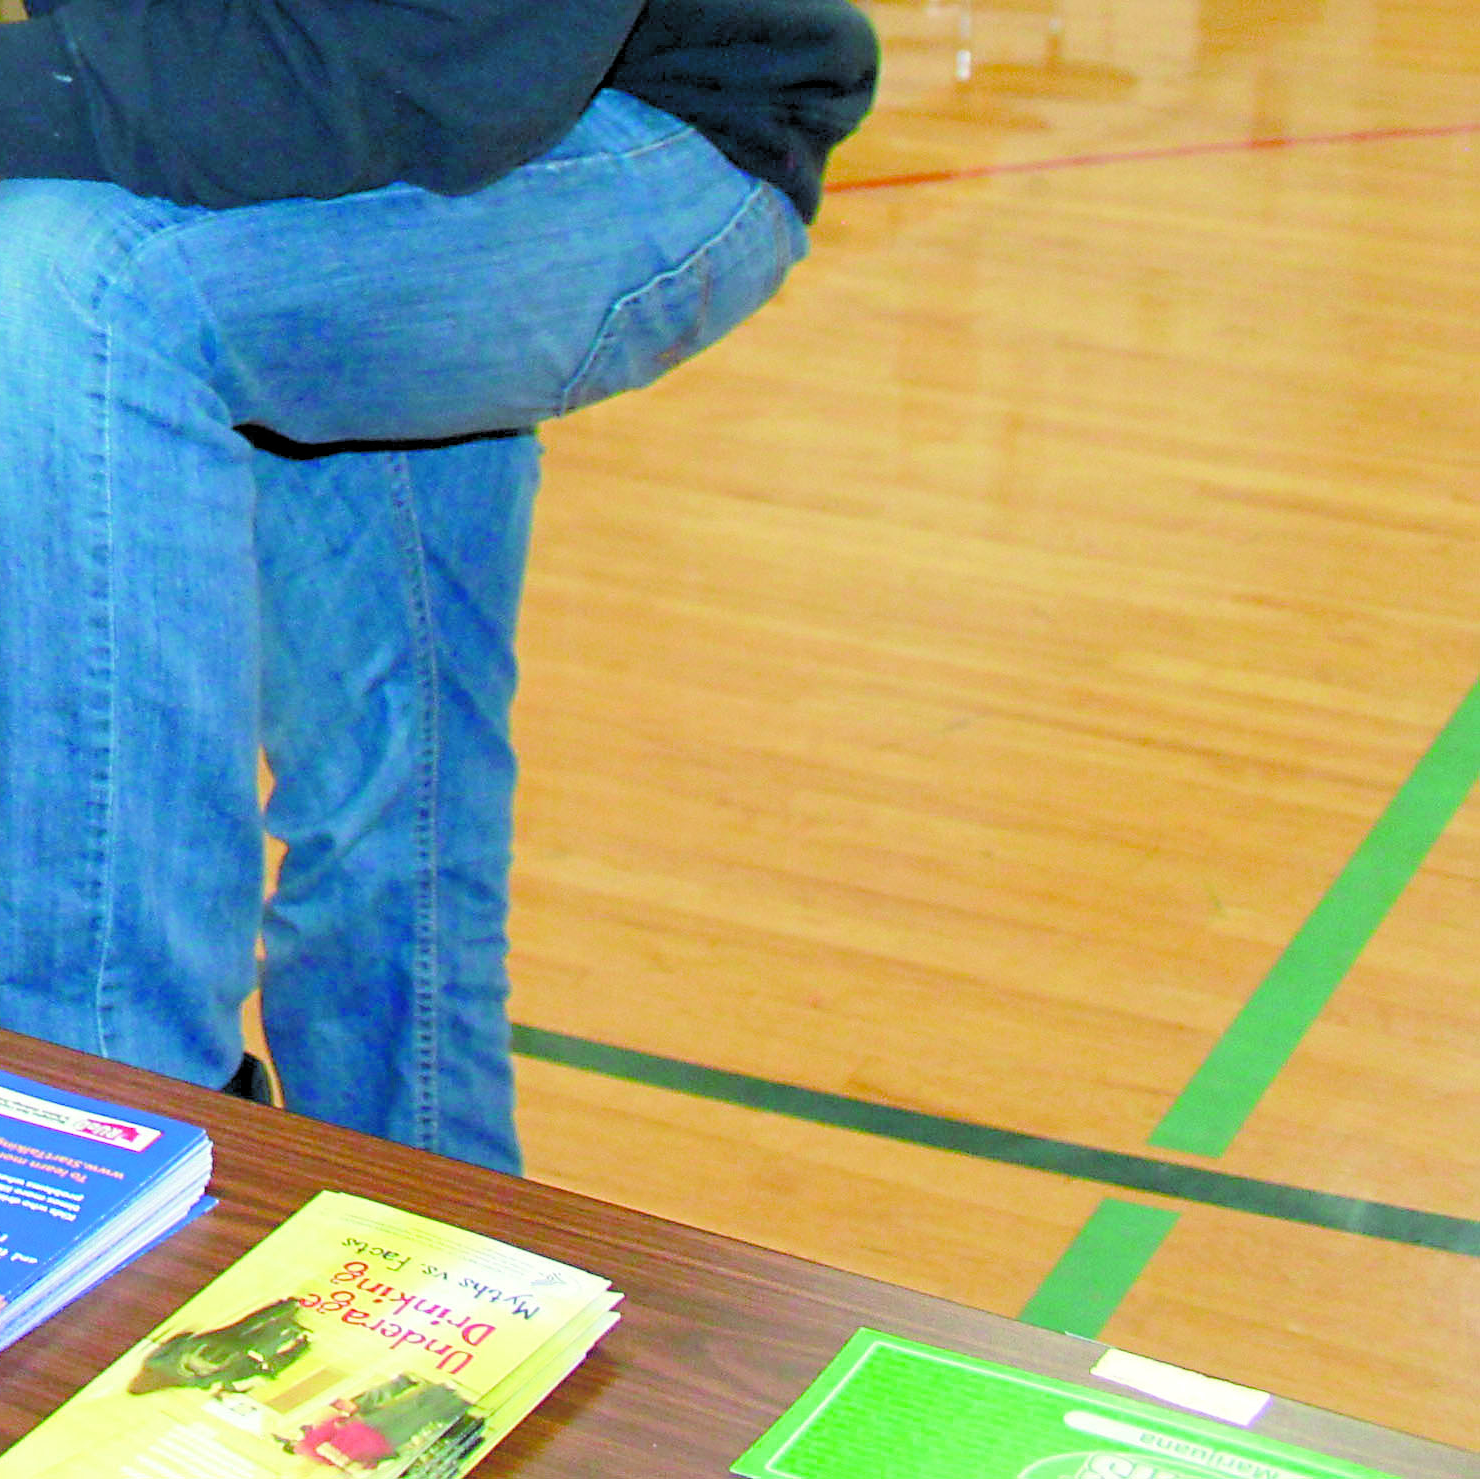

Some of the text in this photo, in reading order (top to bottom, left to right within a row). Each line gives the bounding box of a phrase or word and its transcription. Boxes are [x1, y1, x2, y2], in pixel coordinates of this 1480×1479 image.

[28, 1160, 70, 1178] learn
[68, 1171, 88, 1184] To
[9, 1251, 39, 1265] and
[340, 1236, 413, 1273] Facts
[419, 1262, 449, 1284] vs.
[329, 1260, 497, 1348] Drinking
[457, 1276, 541, 1322] Myths
[297, 1289, 475, 1376] Underage
[1137, 1431, 1275, 1479] Marijuana
